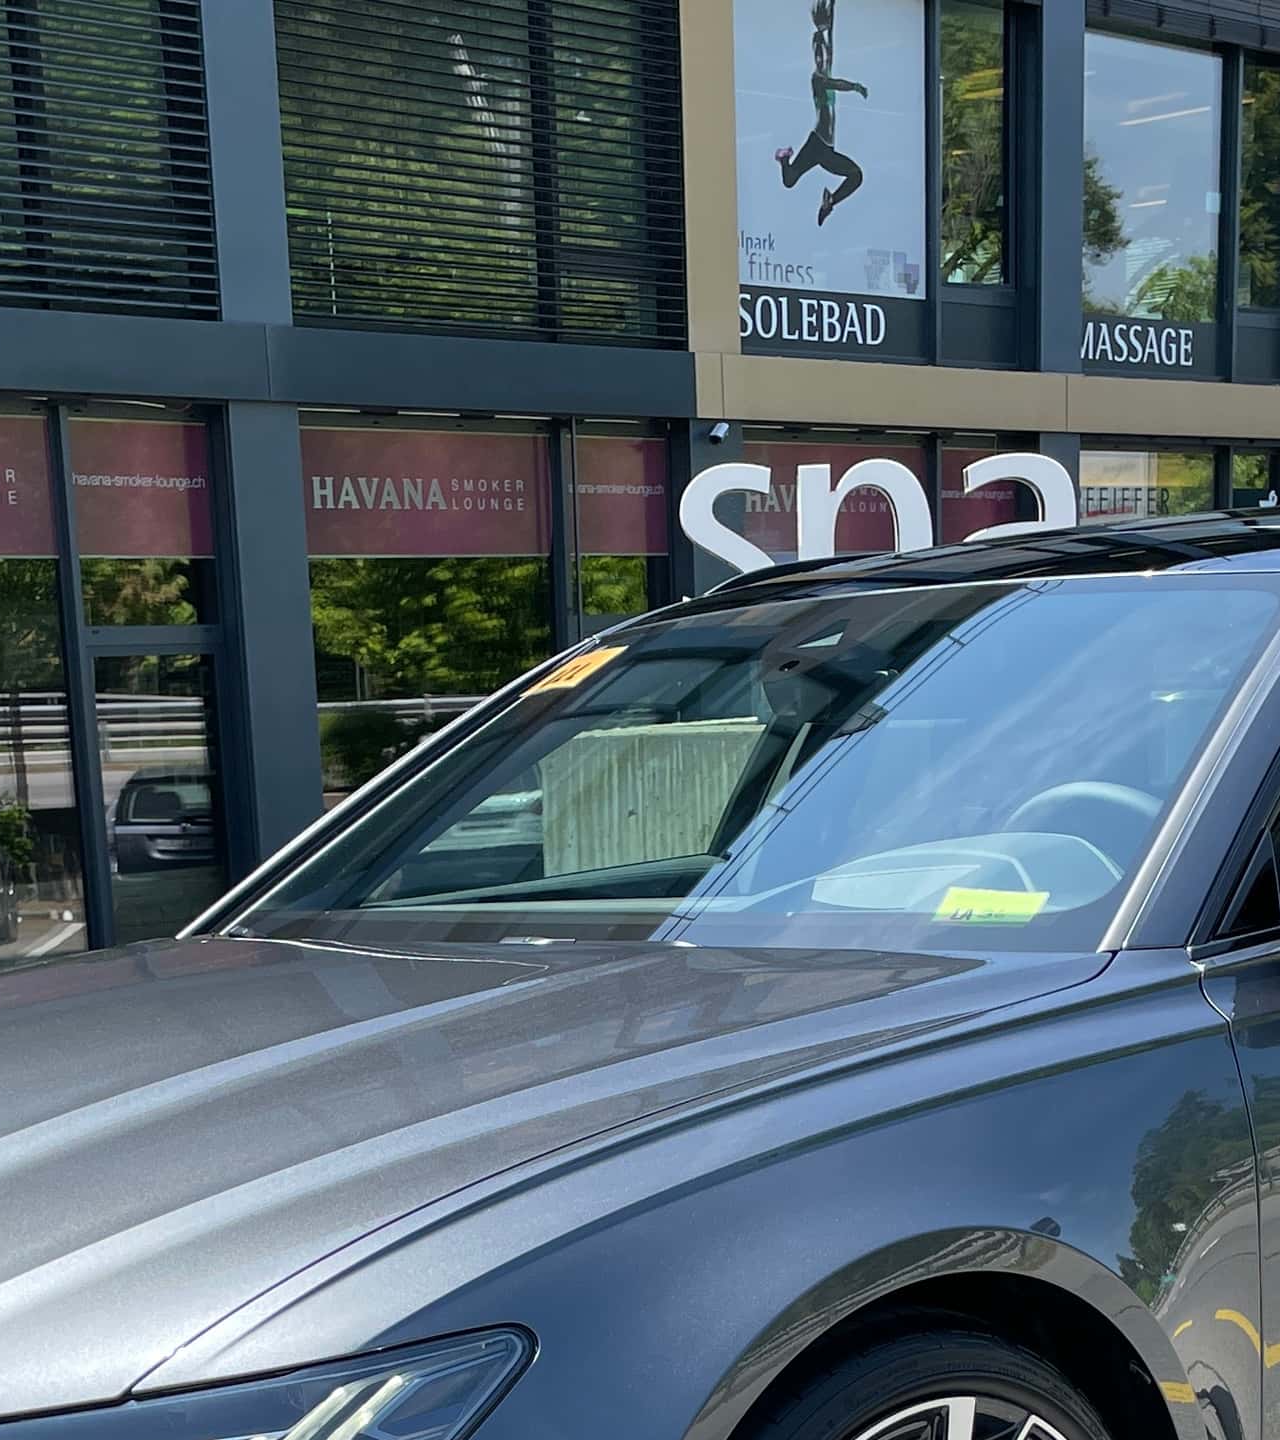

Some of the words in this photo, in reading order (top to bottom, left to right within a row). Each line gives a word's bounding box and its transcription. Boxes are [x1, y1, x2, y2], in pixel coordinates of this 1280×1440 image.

[747, 252, 815, 285] fitness
[739, 293, 887, 346] SOLEBAD
[311, 476, 448, 510] HAVANA
[451, 479, 525, 493] SMOKER
[451, 497, 526, 512] LOUNGE
